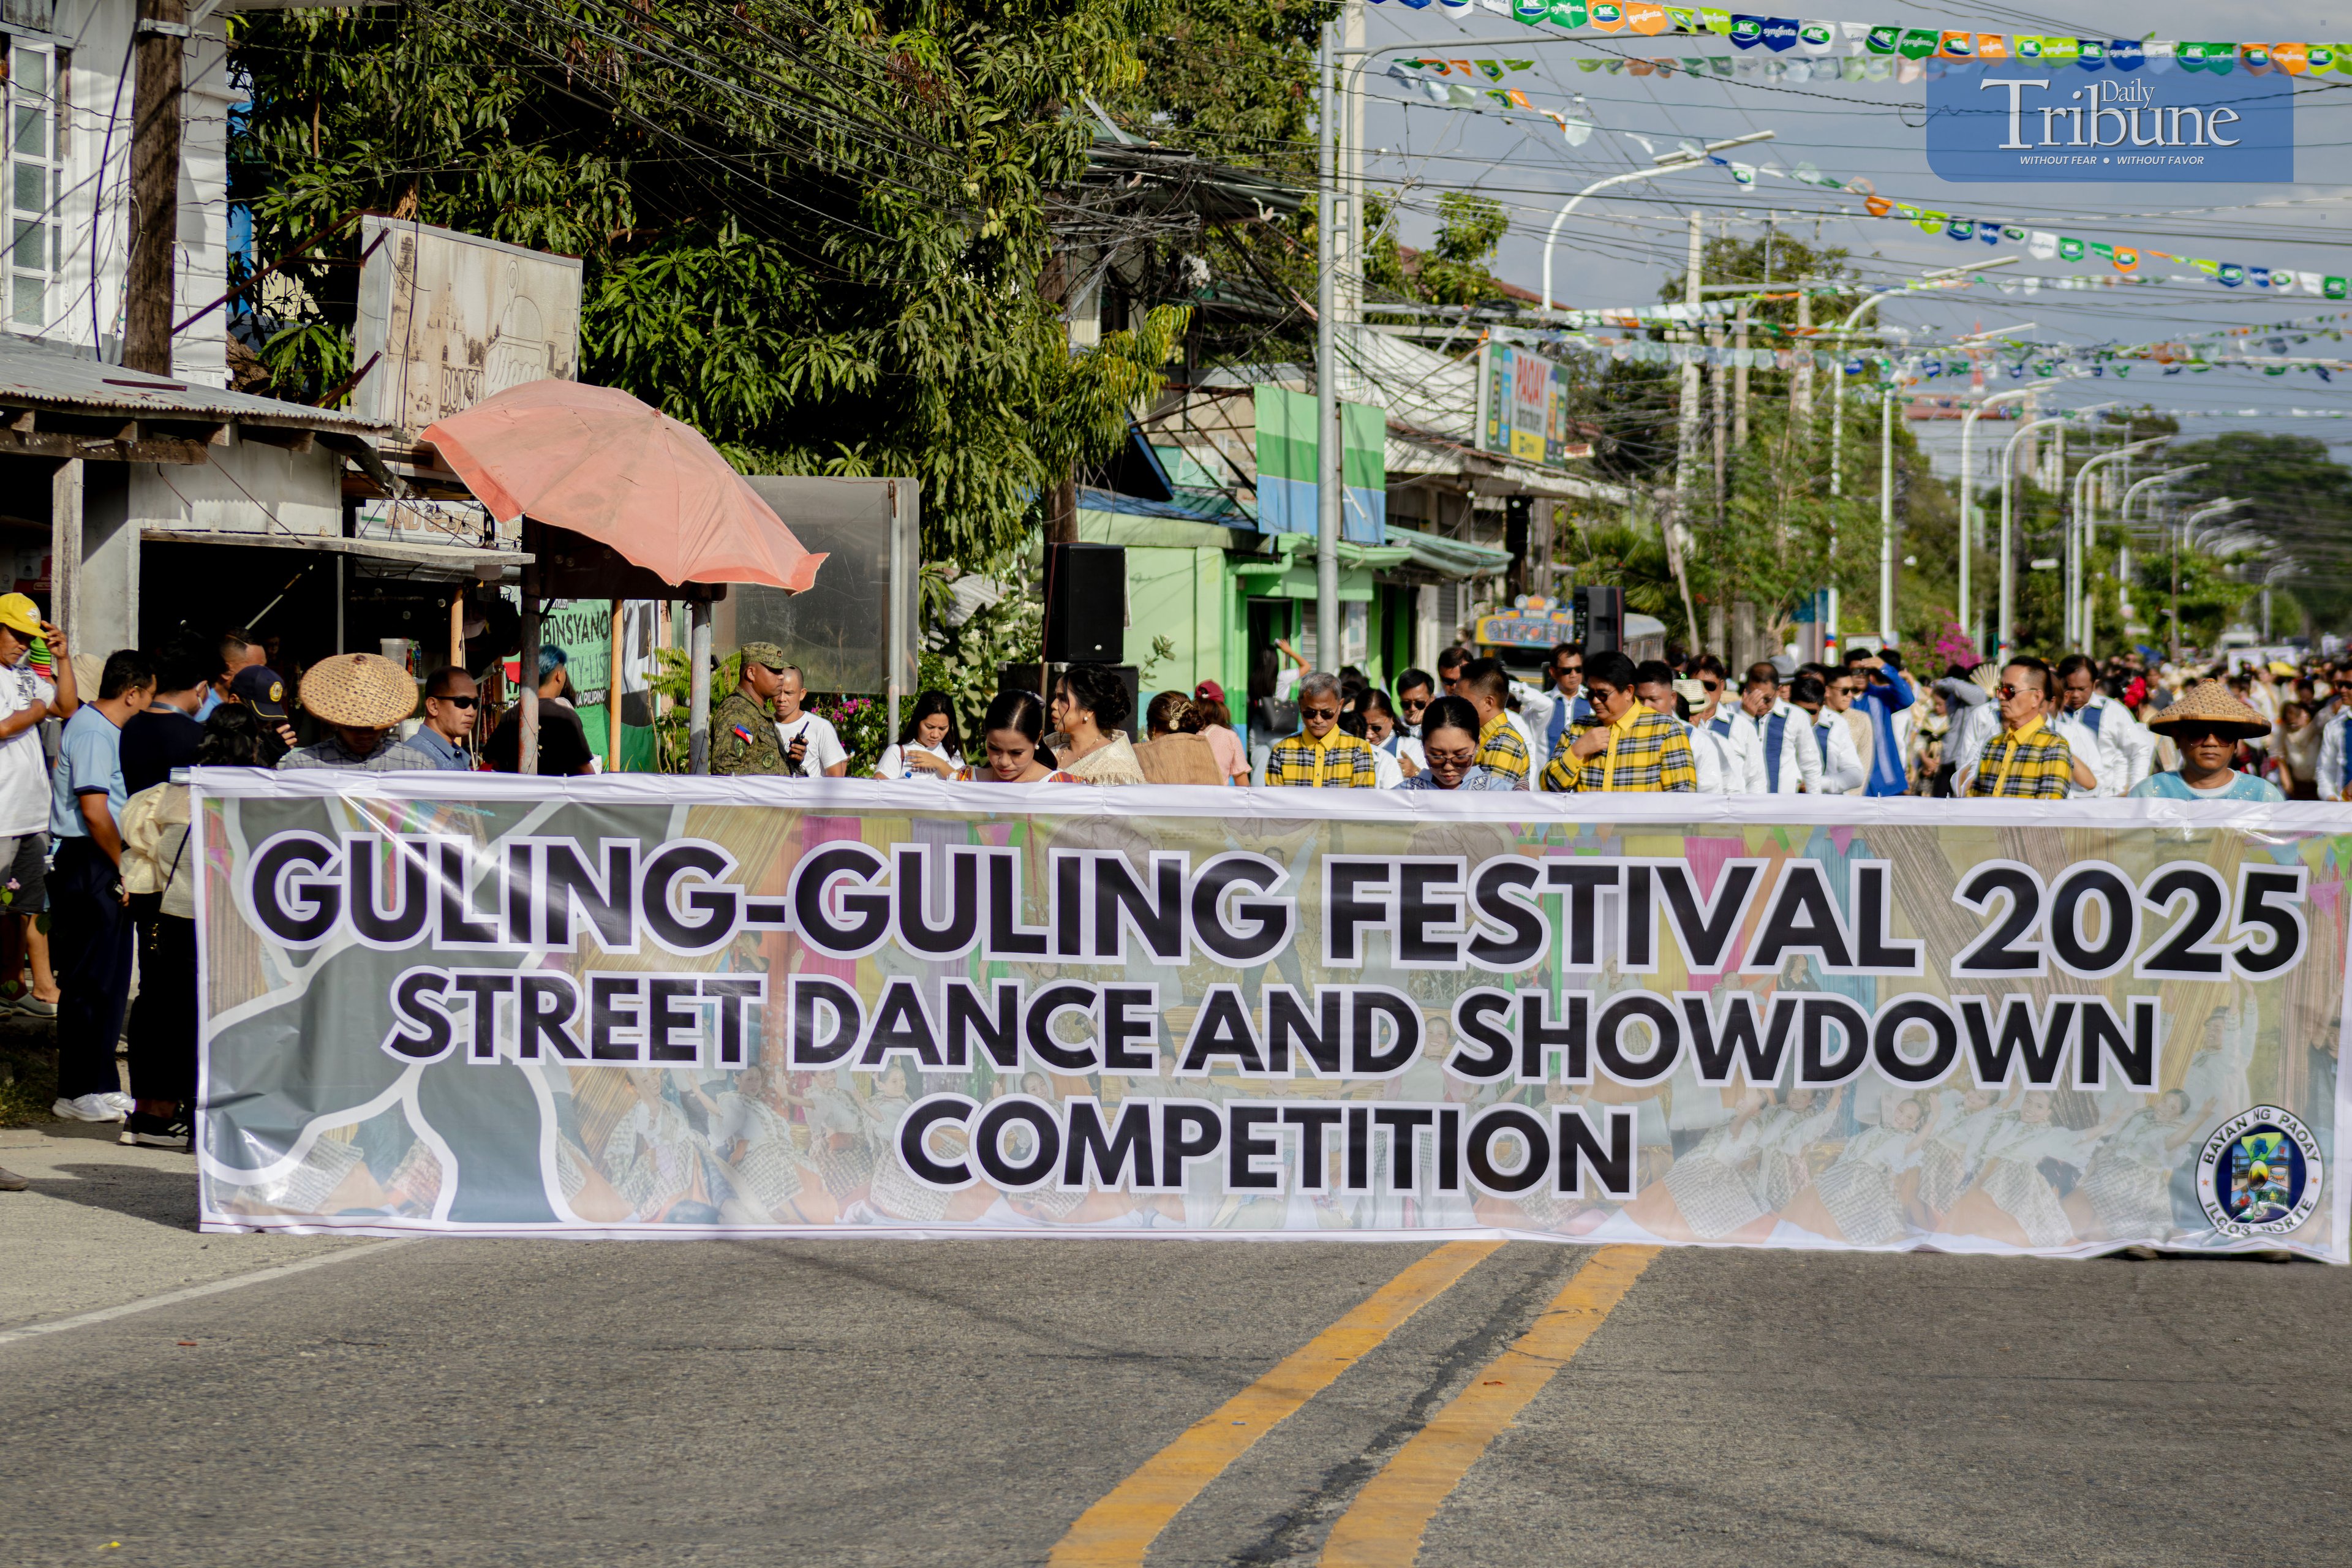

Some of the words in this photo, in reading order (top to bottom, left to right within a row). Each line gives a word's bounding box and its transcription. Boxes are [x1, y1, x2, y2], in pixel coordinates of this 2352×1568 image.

[1551, 2, 1585, 13] syngenta
[1629, 10, 1662, 23] syngenta
[1738, 22, 1755, 32] NK
[1763, 26, 1796, 37] syngenta
[1811, 29, 1826, 39] NK
[1902, 37, 1935, 47] syngenta
[2044, 43, 2076, 55] syngenta
[2084, 46, 2099, 56] NK
[2109, 47, 2141, 57] syngenta
[2186, 47, 2204, 58] NK
[2312, 50, 2328, 59] NK
[441, 368, 469, 410] BUY
[1516, 355, 1546, 408] PAOAY
[385, 504, 421, 530] AND
[539, 609, 609, 646] BINSYANO
[567, 652, 611, 687] TY-LIST
[583, 687, 606, 705] PILIPINO
[255, 840, 1286, 959] GULING-GULING
[1323, 863, 1915, 969] FESTIVAL
[1962, 869, 2298, 973] 2025
[393, 975, 760, 1063] STREET
[797, 982, 1152, 1069] DANCE
[1183, 992, 1418, 1072] AND
[1452, 994, 2152, 1086] SHOWDOWN
[2202, 1117, 2247, 1165] BAYAN
[2253, 1108, 2271, 1122] NG
[2277, 1114, 2320, 1163] PAOAY
[902, 1101, 1630, 1193] COMPETITION
[2204, 1200, 2251, 1235] ILOOS
[2258, 1197, 2313, 1233] NORTE
